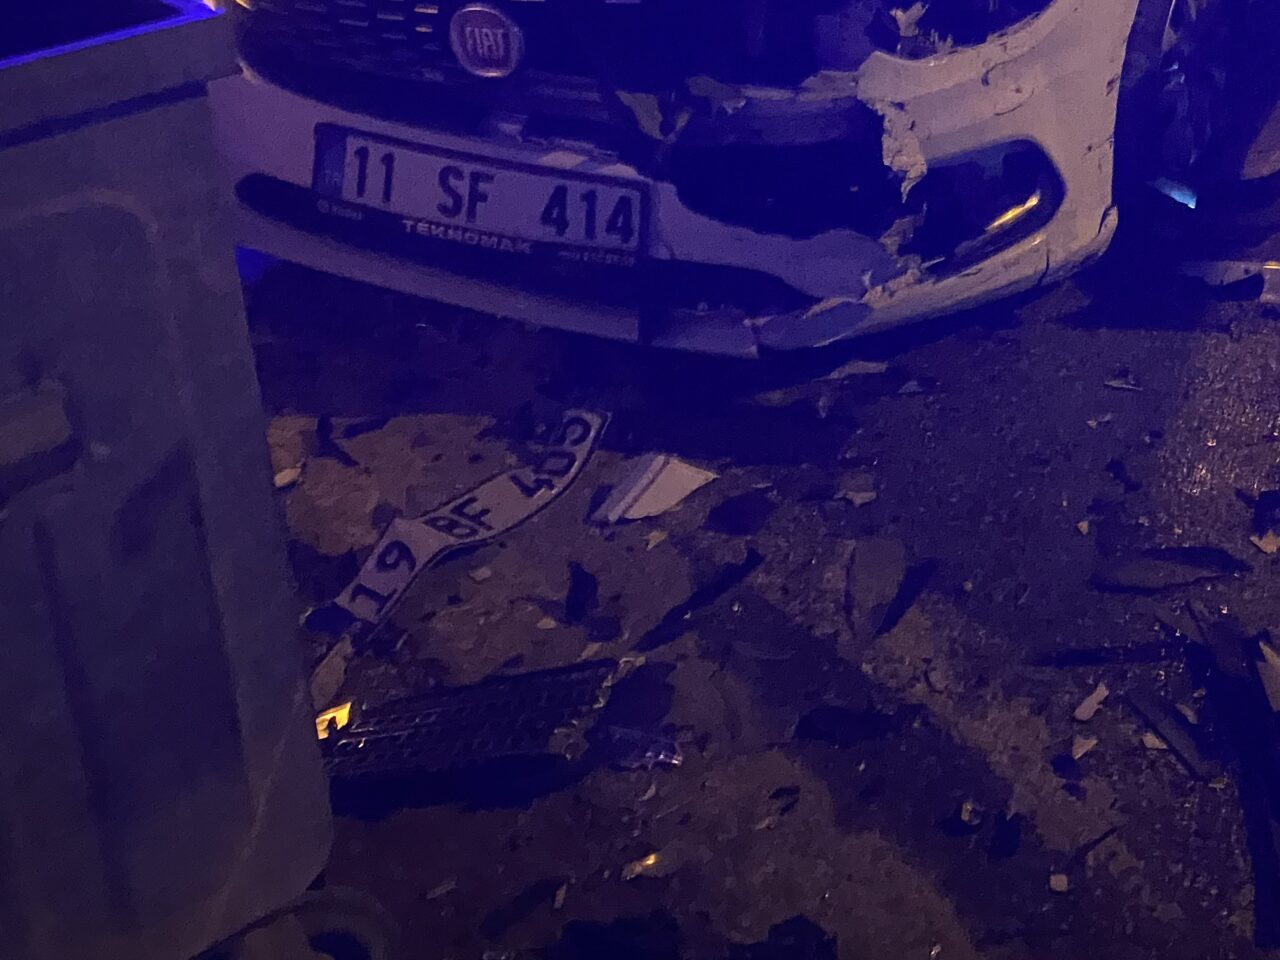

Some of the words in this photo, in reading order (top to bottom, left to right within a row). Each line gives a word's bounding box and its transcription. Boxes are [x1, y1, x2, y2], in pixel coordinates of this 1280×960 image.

[463, 26, 505, 57] FIAT
[354, 146, 395, 203] 11
[436, 165, 494, 223] SF
[540, 183, 635, 244] 414
[350, 540, 417, 617] 19
